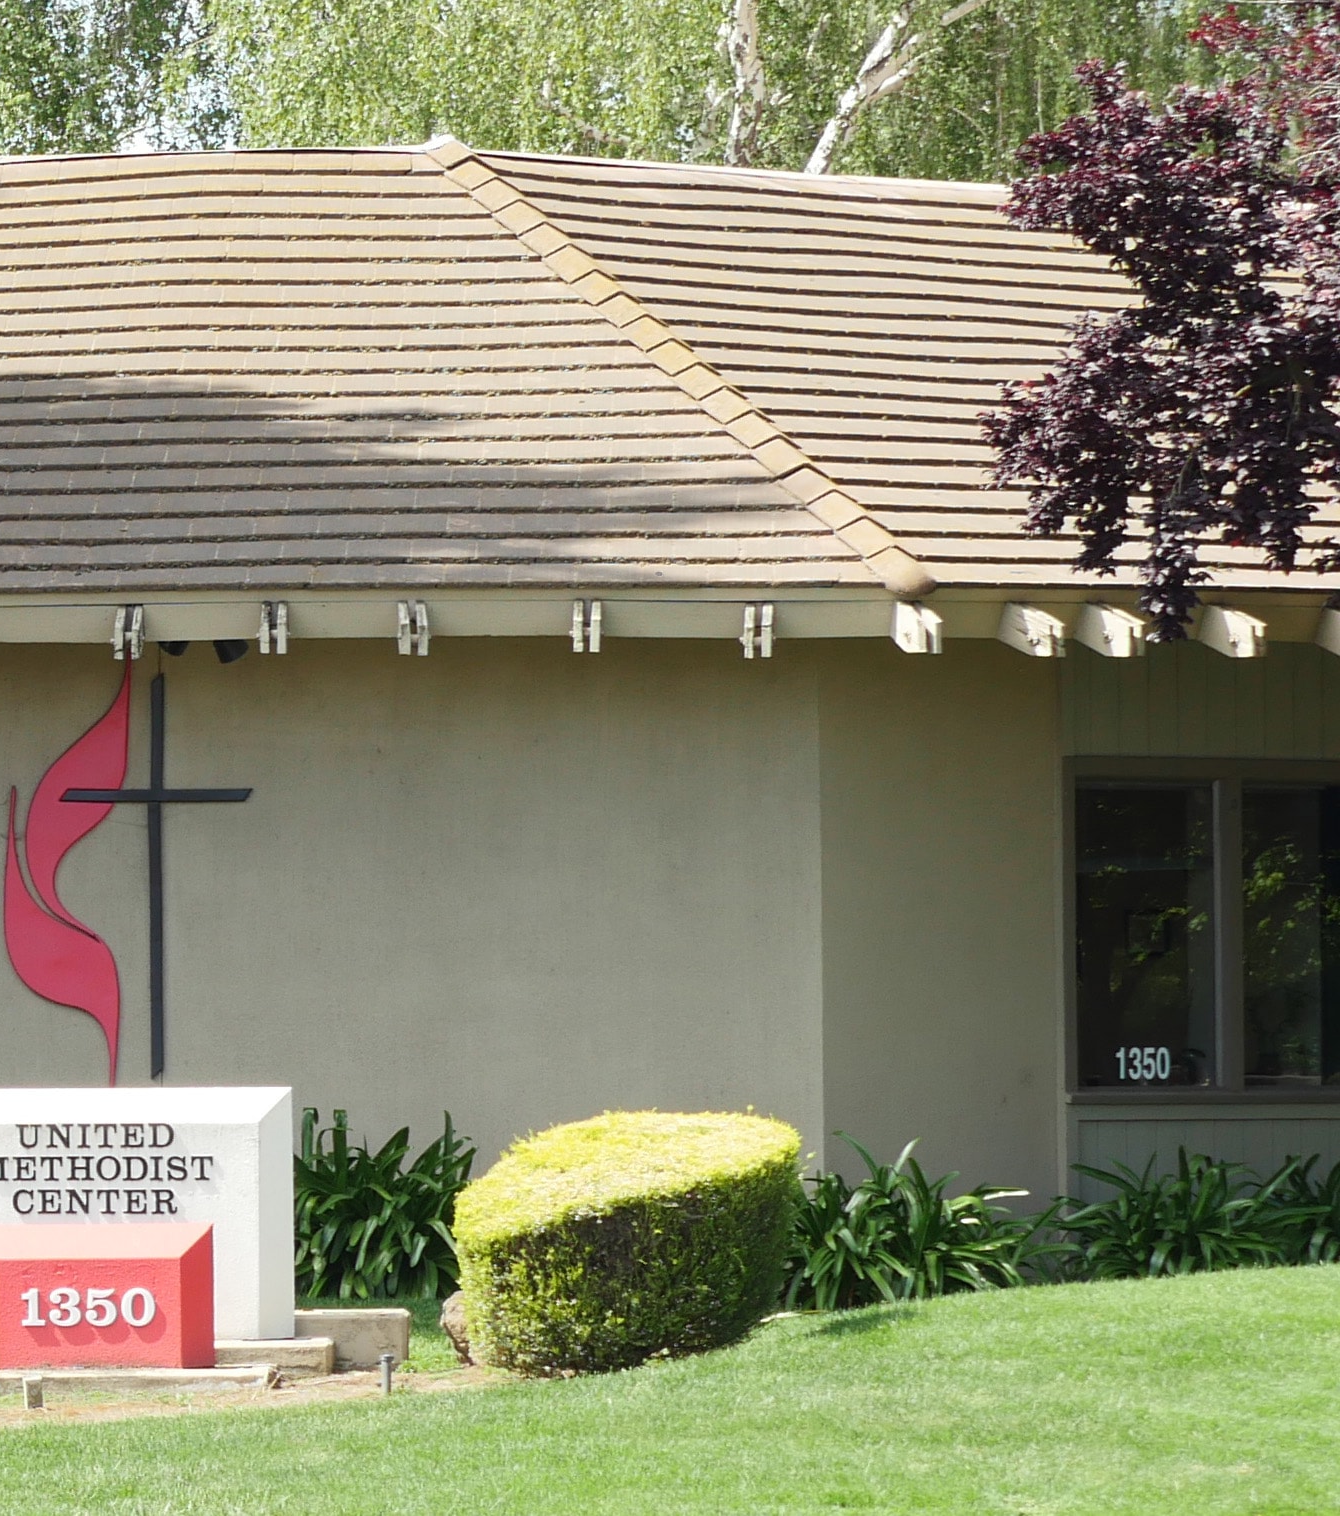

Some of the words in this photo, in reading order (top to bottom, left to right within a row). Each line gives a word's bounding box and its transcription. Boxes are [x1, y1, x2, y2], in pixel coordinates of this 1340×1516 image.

[1115, 1047, 1171, 1080] 1350
[15, 1123, 175, 1149] UNITED
[12, 1189, 178, 1215] CENTER
[20, 1287, 156, 1327] 1350
